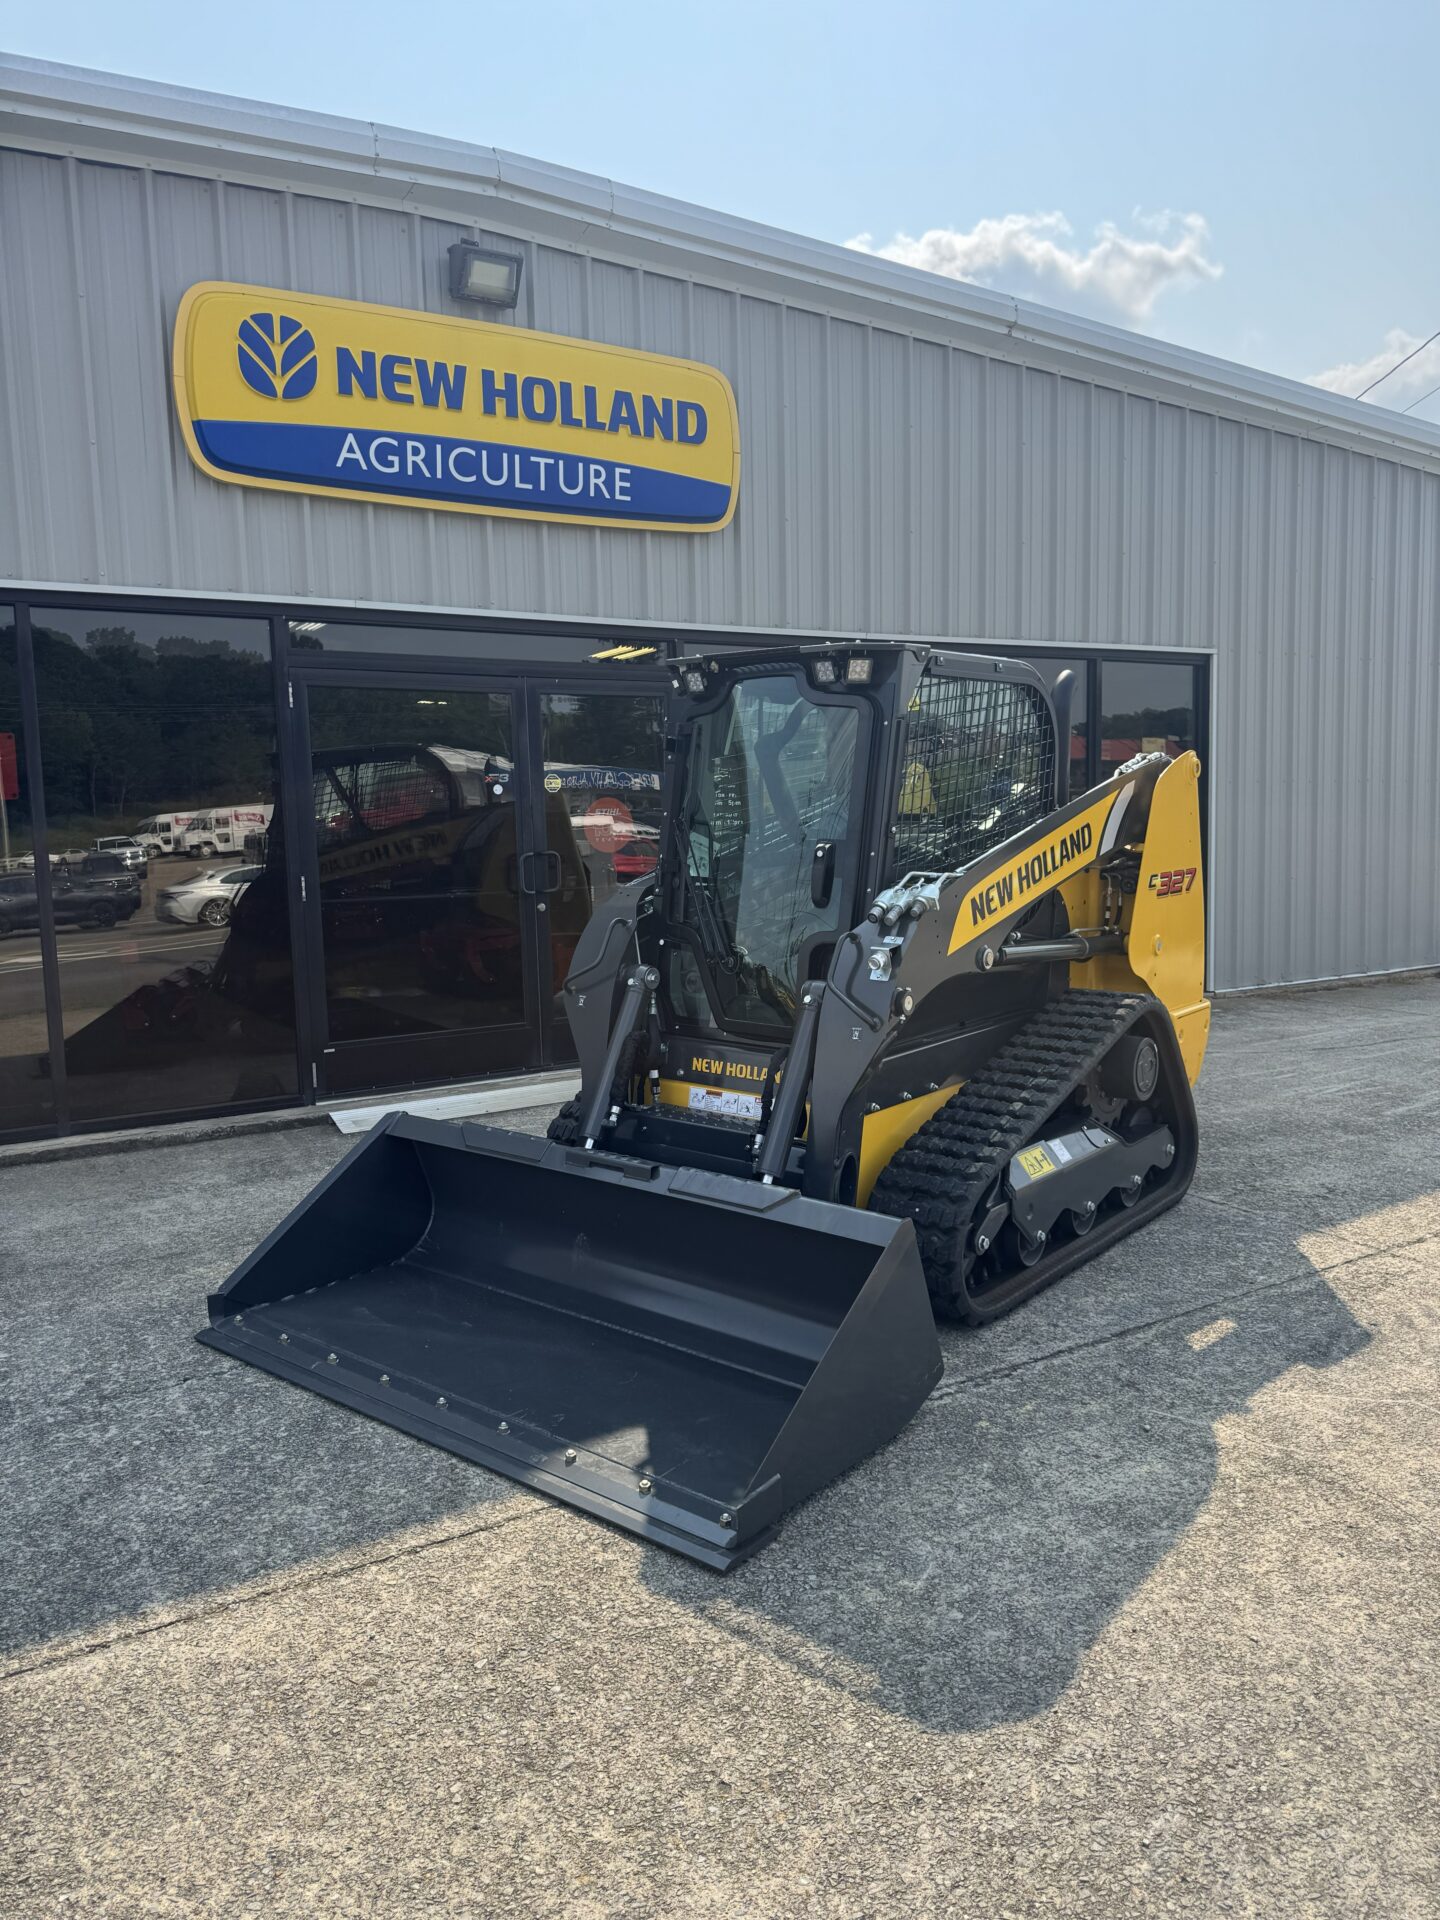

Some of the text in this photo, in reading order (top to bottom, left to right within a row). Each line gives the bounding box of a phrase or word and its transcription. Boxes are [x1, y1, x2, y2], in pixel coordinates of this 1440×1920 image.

[336, 346, 709, 446] NEW HOLLAND
[336, 432, 632, 502] AGRICULTURE
[970, 822, 1093, 927] NEW HOLLAND
[692, 1057, 724, 1075] NEW
